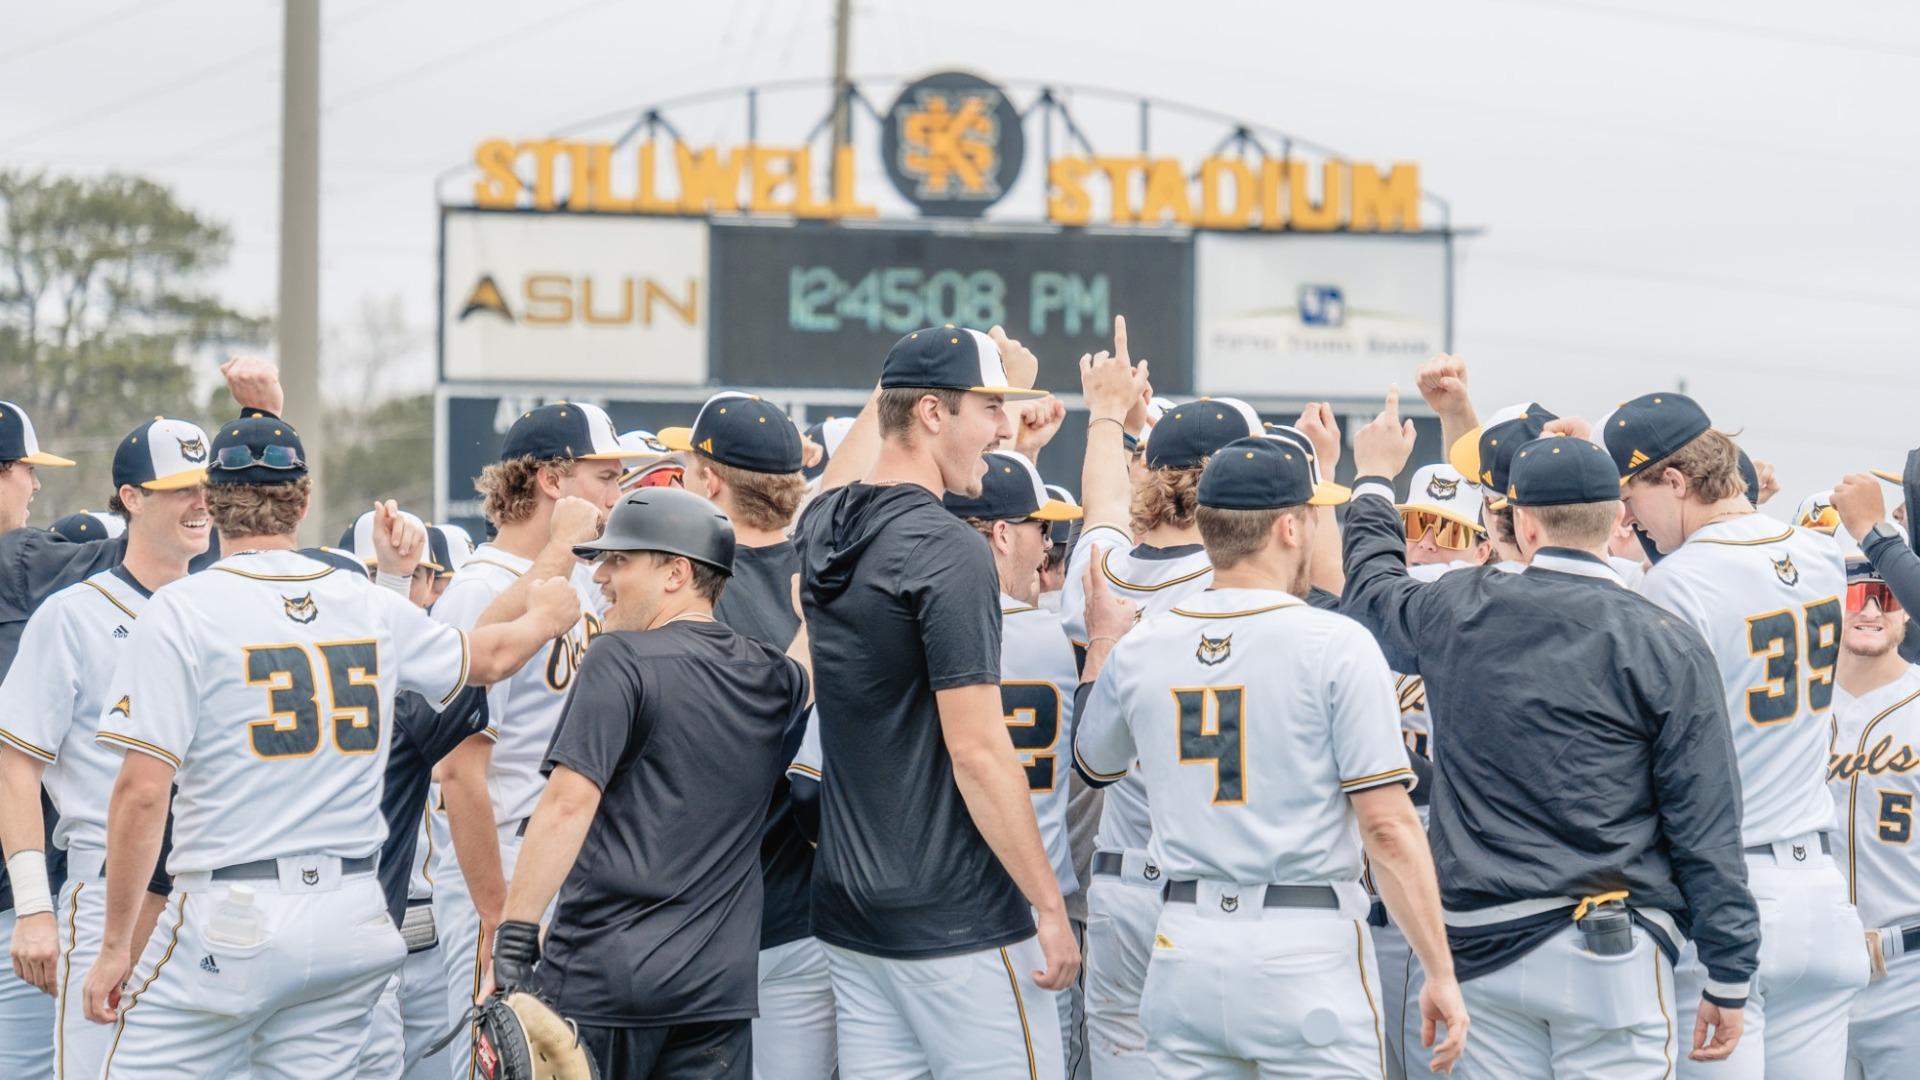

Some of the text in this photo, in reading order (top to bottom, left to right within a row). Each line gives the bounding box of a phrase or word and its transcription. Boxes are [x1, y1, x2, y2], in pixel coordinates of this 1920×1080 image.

[473, 137, 1423, 232] STILLWELL STADIUM
[457, 273, 700, 326] ASUN
[1028, 269, 1111, 338] PM
[240, 639, 383, 762] 35
[1743, 595, 1845, 728] 39
[1170, 684, 1248, 806] 4
[1824, 732, 1920, 783] wls
[1877, 788, 1914, 845] 5
